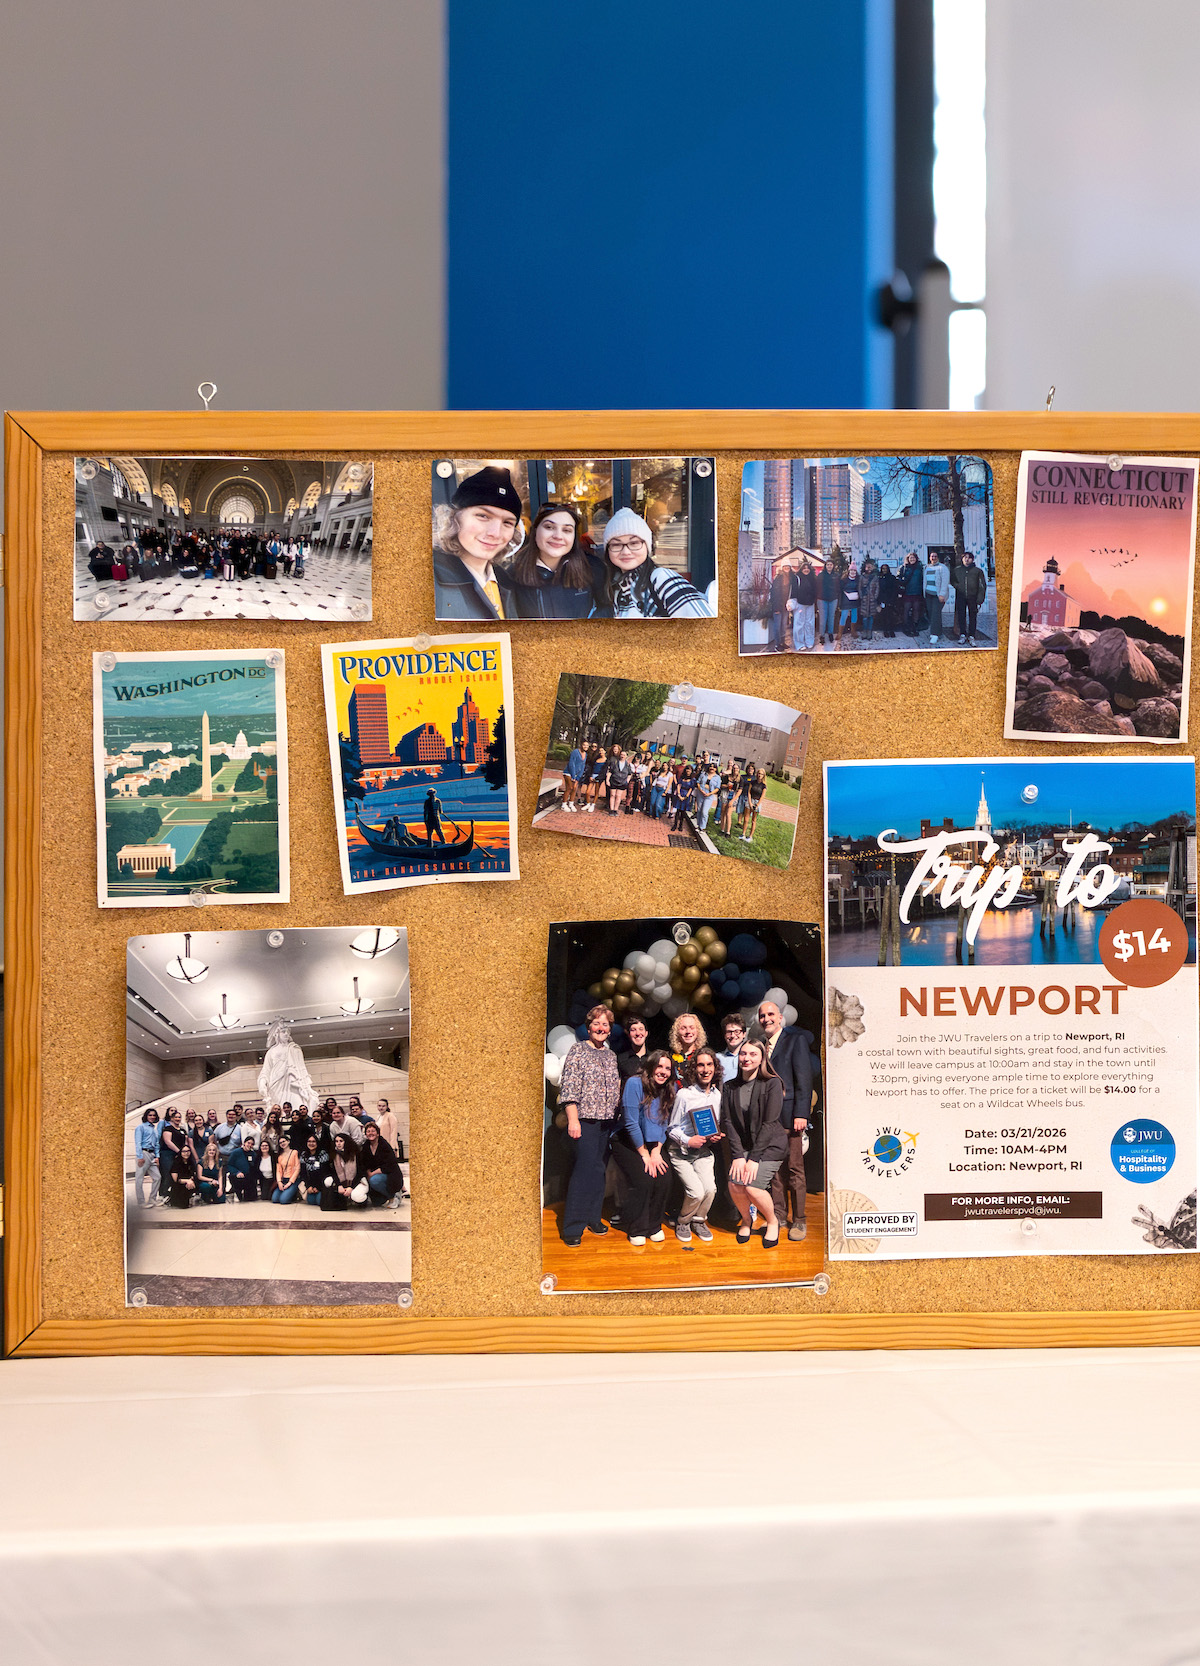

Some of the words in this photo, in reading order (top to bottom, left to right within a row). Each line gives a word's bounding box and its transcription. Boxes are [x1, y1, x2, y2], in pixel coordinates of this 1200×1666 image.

[1033, 465, 1188, 493] CONNECTICUT
[1032, 490, 1067, 504] STILL
[1074, 492, 1186, 510] REVOLUTIONARY
[339, 649, 497, 684] PROVIDENCE
[112, 667, 246, 701] WASHINGTON
[249, 668, 266, 677] DC
[420, 676, 452, 685] RHODE
[460, 674, 498, 682] ISLAND
[356, 869, 375, 879] THE
[385, 862, 470, 876] RENAISSANCE
[480, 861, 505, 870] CITY
[877, 829, 1023, 946] Trip
[1056, 832, 1122, 909] to
[1112, 928, 1172, 963] $14
[900, 985, 1128, 1017] NEWPORT
[897, 1034, 917, 1043] Join
[920, 1034, 936, 1042] the
[939, 1034, 961, 1043] JWU
[964, 1033, 1007, 1042] Travelers
[1034, 1032, 1050, 1042] trip
[1053, 1033, 1062, 1041] to
[1066, 1032, 1112, 1042] Newport,
[1115, 1032, 1125, 1040] RI
[866, 1048, 894, 1057] costal
[924, 1047, 945, 1056] with
[949, 1046, 992, 1056] beautiful
[994, 1046, 1025, 1056] sights,
[1028, 1046, 1053, 1056] great
[1057, 1046, 1080, 1055] food,
[1083, 1046, 1101, 1054] and
[1104, 1045, 1120, 1054] fun
[1123, 1045, 1167, 1054] activities.
[870, 1062, 886, 1070] We
[889, 1061, 904, 1070] will
[908, 1061, 932, 1069] leave
[935, 1062, 974, 1070] campus
[977, 1061, 986, 1069] at
[989, 1060, 1029, 1068] 10:00am
[1032, 1059, 1050, 1067] and
[1053, 1060, 1073, 1069] stay
[1076, 1059, 1084, 1067] in
[1087, 1059, 1104, 1067] the
[1134, 1059, 1156, 1067] until
[872, 1075, 910, 1084] 3:30pm,
[912, 1074, 942, 1084] giving
[945, 1075, 989, 1084] everyone
[992, 1073, 1023, 1082] ample
[1025, 1073, 1048, 1081] time
[1063, 1072, 1099, 1082] explore
[1102, 1072, 1153, 1082] everything
[865, 1088, 908, 1098] Newport
[911, 1088, 927, 1096] has
[930, 1088, 940, 1096] to
[942, 1087, 966, 1096] offer.
[969, 1086, 987, 1095] The
[990, 1086, 1013, 1096] price
[1016, 1086, 1029, 1094] for
[1040, 1086, 1068, 1094] ticket
[1070, 1085, 1086, 1094] will
[1090, 1085, 1101, 1094] be
[1104, 1085, 1136, 1095] $14.00
[1139, 1085, 1152, 1094] for
[1155, 1086, 1160, 1094] a
[940, 1101, 960, 1109] seat
[986, 1099, 1023, 1108] Wildcat
[1027, 1099, 1062, 1108] Wheels
[1066, 1098, 1085, 1107] bus.
[876, 1126, 901, 1136] JWU
[964, 1129, 997, 1139] Date:
[1001, 1127, 1067, 1139] 03/21/2026
[1138, 1131, 1163, 1142] JWU
[964, 1145, 998, 1155] Time:
[1001, 1144, 1067, 1154] 10AM-4PM
[861, 1148, 915, 1178] TRAVELERS
[1119, 1155, 1167, 1164] Hospitality
[949, 1162, 1006, 1172] Location:
[1010, 1161, 1067, 1172] Newport,
[1070, 1161, 1082, 1170] RI
[1129, 1164, 1166, 1172] Business
[951, 1197, 972, 1206] FOR
[975, 1196, 1005, 1205] MORE
[1007, 1196, 1034, 1205] INFO,
[1036, 1196, 1070, 1204] EMAIL:
[964, 1206, 1061, 1217] jwutravelerspvd@jwu.
[847, 1216, 900, 1224] APPROVED
